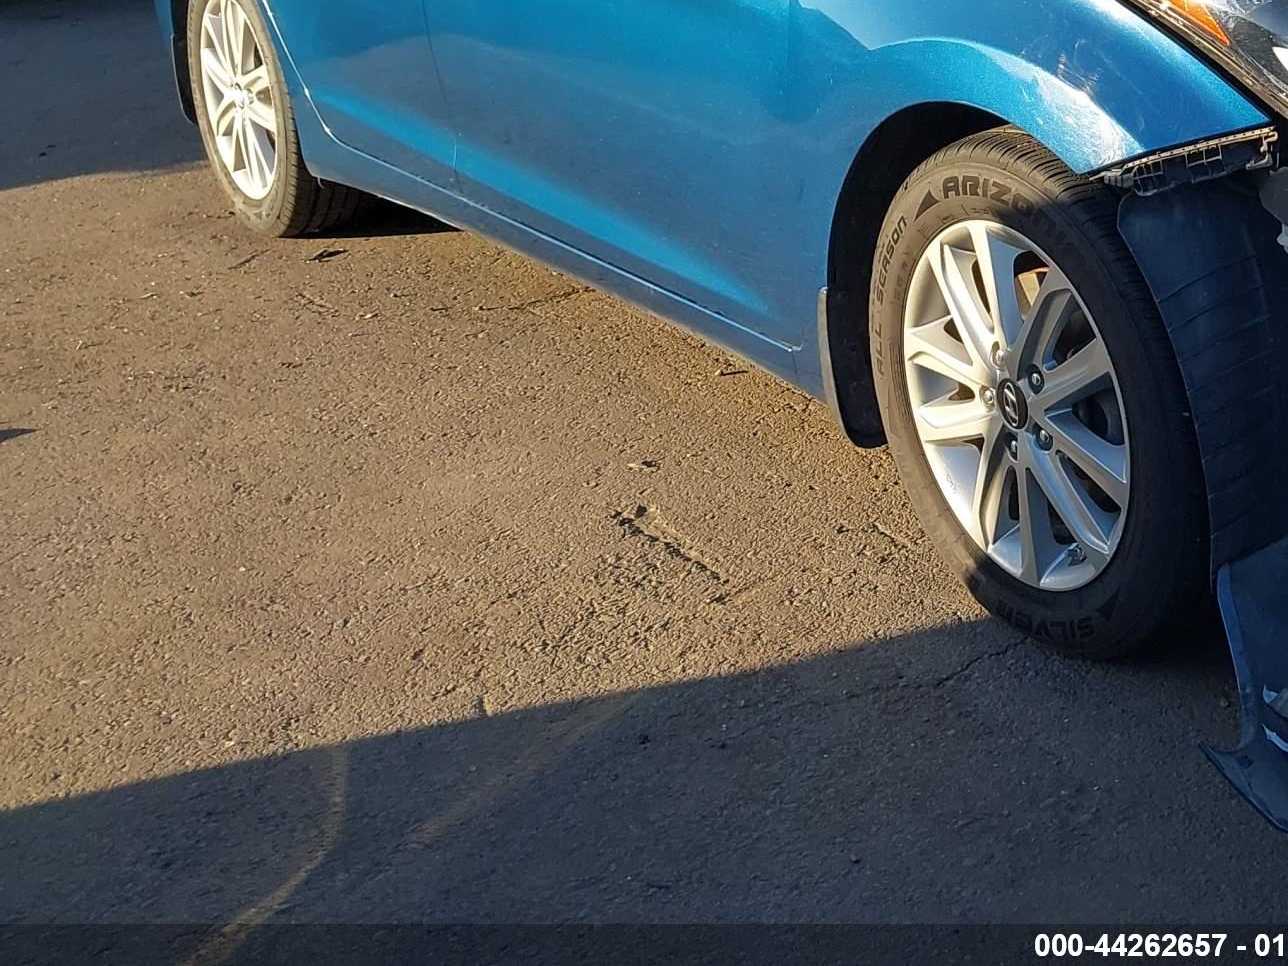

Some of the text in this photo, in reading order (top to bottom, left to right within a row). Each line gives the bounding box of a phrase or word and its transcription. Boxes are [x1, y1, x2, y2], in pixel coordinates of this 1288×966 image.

[875, 215, 908, 307] SEASON
[874, 320, 885, 378] ALL
[994, 600, 1096, 643] SILVER
